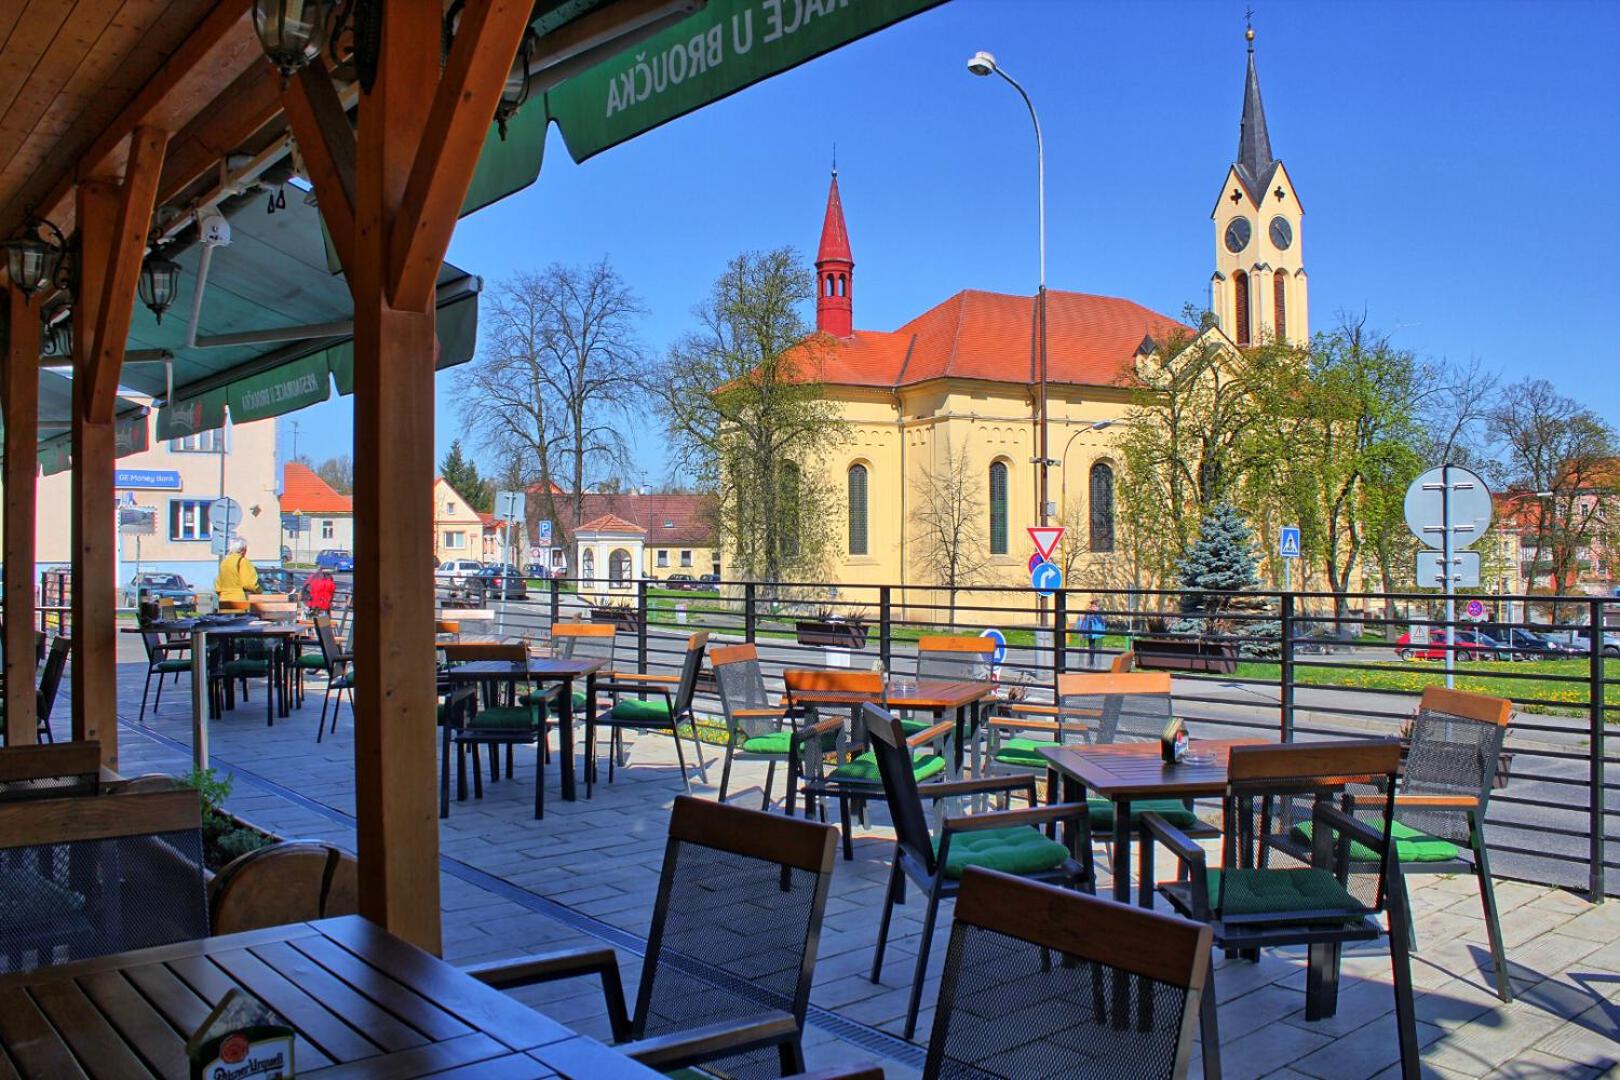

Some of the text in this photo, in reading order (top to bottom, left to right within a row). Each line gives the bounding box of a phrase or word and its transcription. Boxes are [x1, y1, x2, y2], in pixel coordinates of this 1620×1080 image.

[130, 474, 155, 483] Money
[541, 523, 549, 537] P
[214, 1052, 284, 1080] Pilsner Urquell
